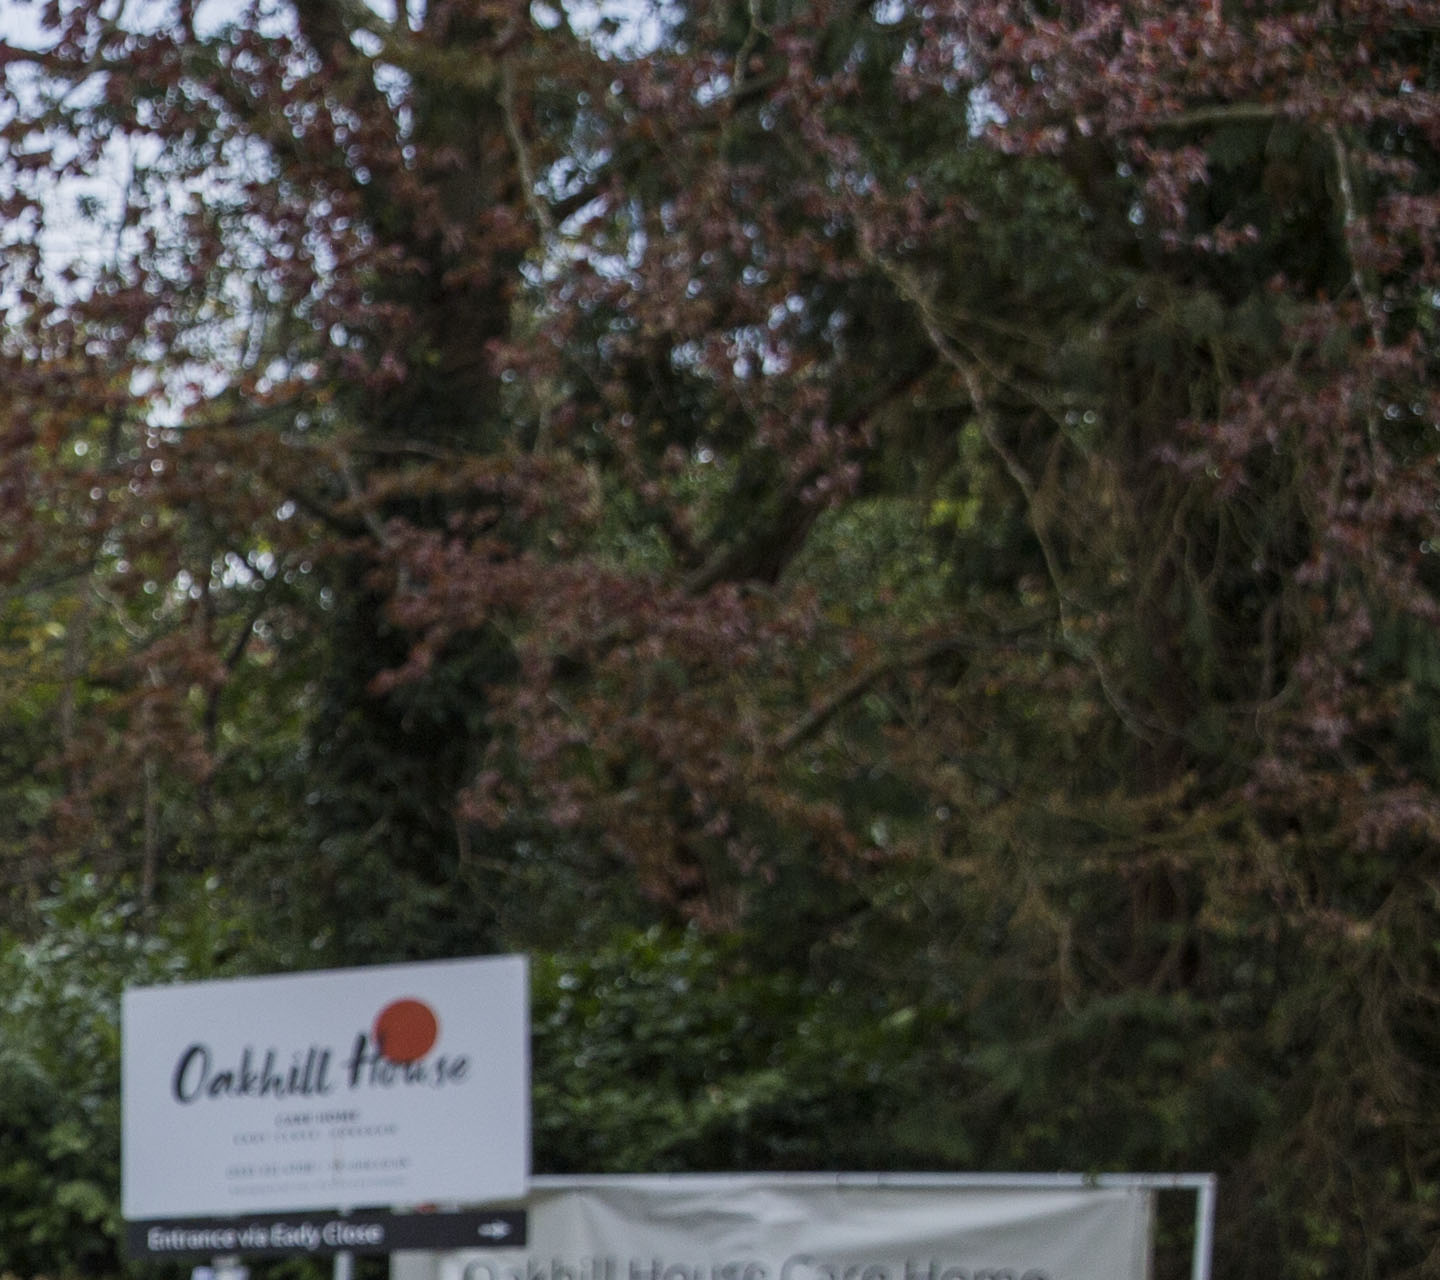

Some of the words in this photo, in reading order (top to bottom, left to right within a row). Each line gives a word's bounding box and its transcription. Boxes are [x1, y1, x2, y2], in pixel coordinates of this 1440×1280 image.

[172, 1042, 332, 1106] Oakhill
[345, 1030, 470, 1091] House
[147, 1225, 236, 1251] Entrance
[238, 1224, 267, 1247] via
[323, 1220, 385, 1247] Close
